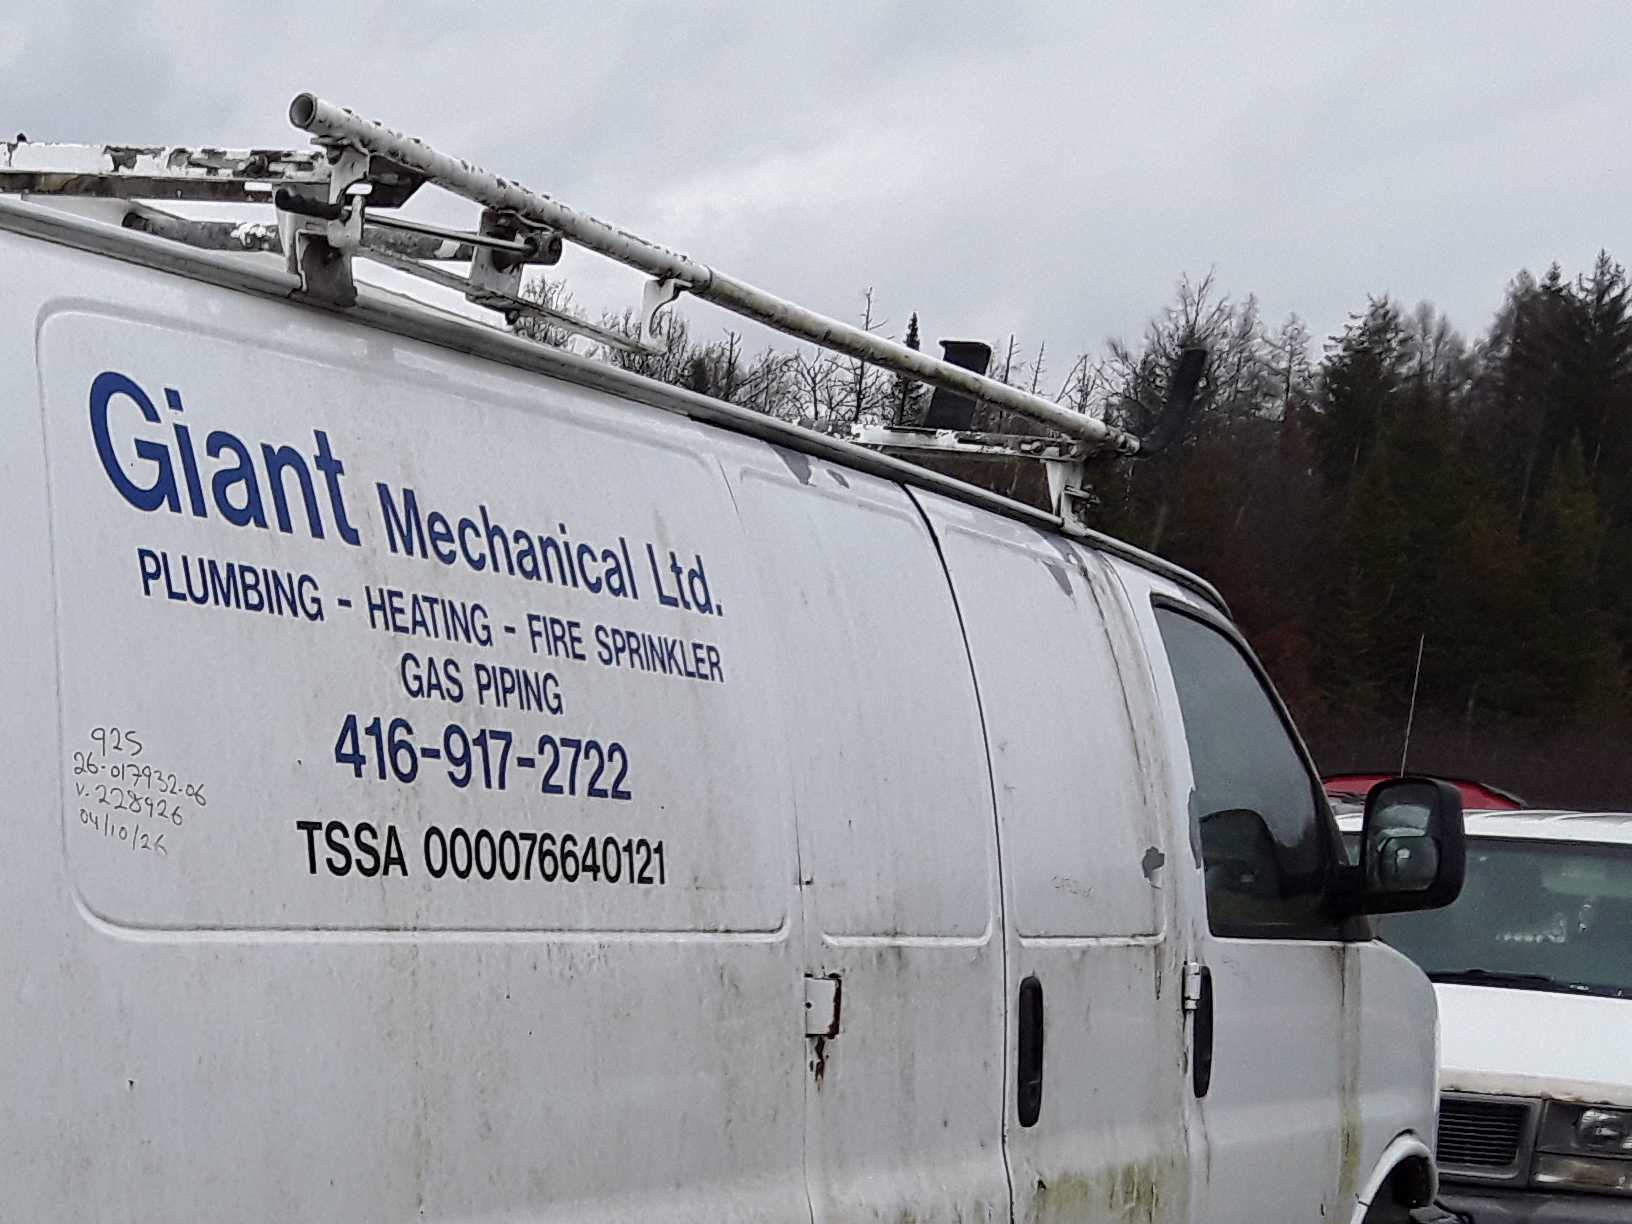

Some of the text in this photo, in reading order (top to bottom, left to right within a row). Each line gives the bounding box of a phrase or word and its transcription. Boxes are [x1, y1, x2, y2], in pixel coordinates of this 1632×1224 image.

[89, 371, 724, 617] Giant Mechanical Ltd.
[137, 548, 325, 622] PLUMBING
[365, 585, 493, 647] HEATING
[527, 613, 586, 661] FIRE
[595, 625, 725, 682] SPRINKLER
[401, 653, 563, 715] GAS PIPING
[90, 727, 143, 757] 925
[335, 714, 632, 800] 416-917-2722
[296, 821, 666, 885] TSSA 000076640121
